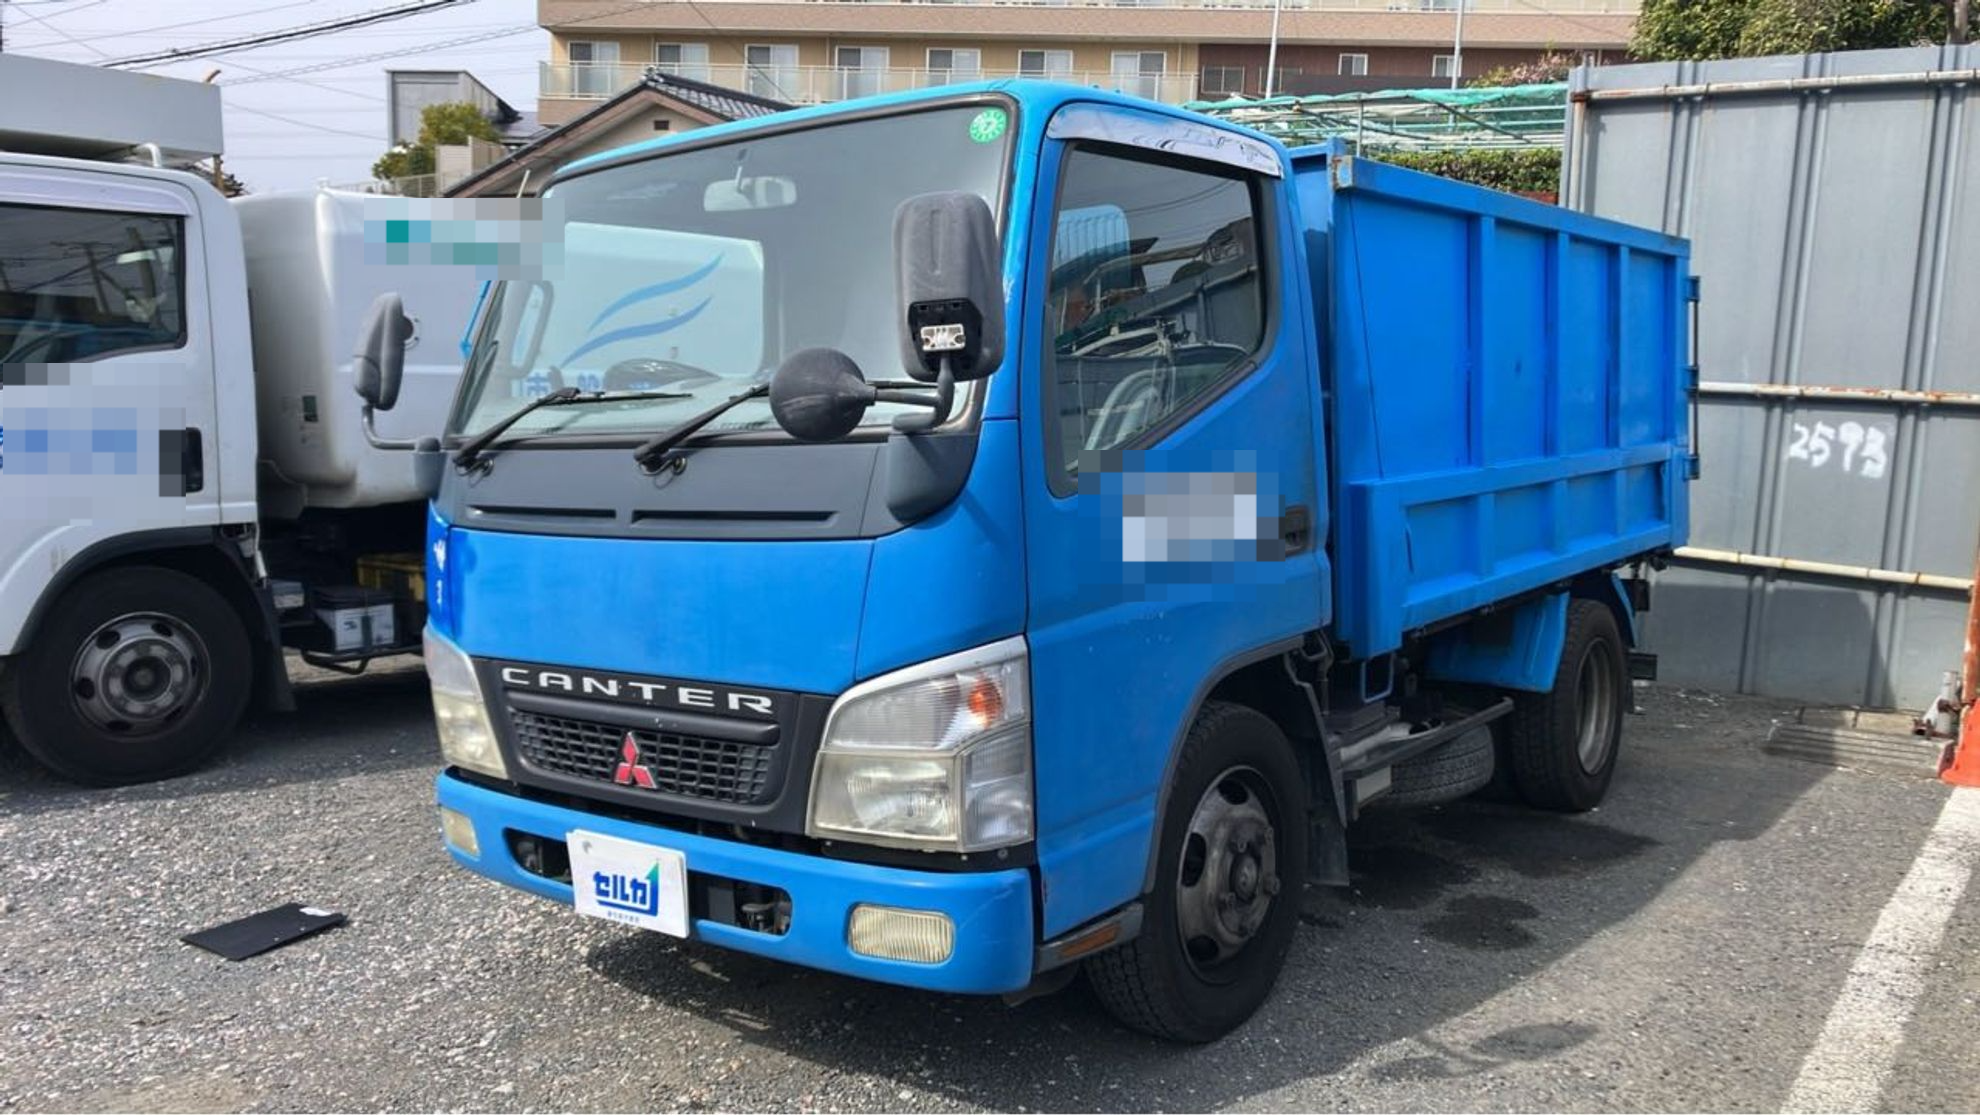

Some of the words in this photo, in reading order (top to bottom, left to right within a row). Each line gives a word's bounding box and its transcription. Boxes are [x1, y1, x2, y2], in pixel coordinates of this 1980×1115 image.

[501, 667, 773, 714] CANTER
[593, 871, 648, 906] セルカ
